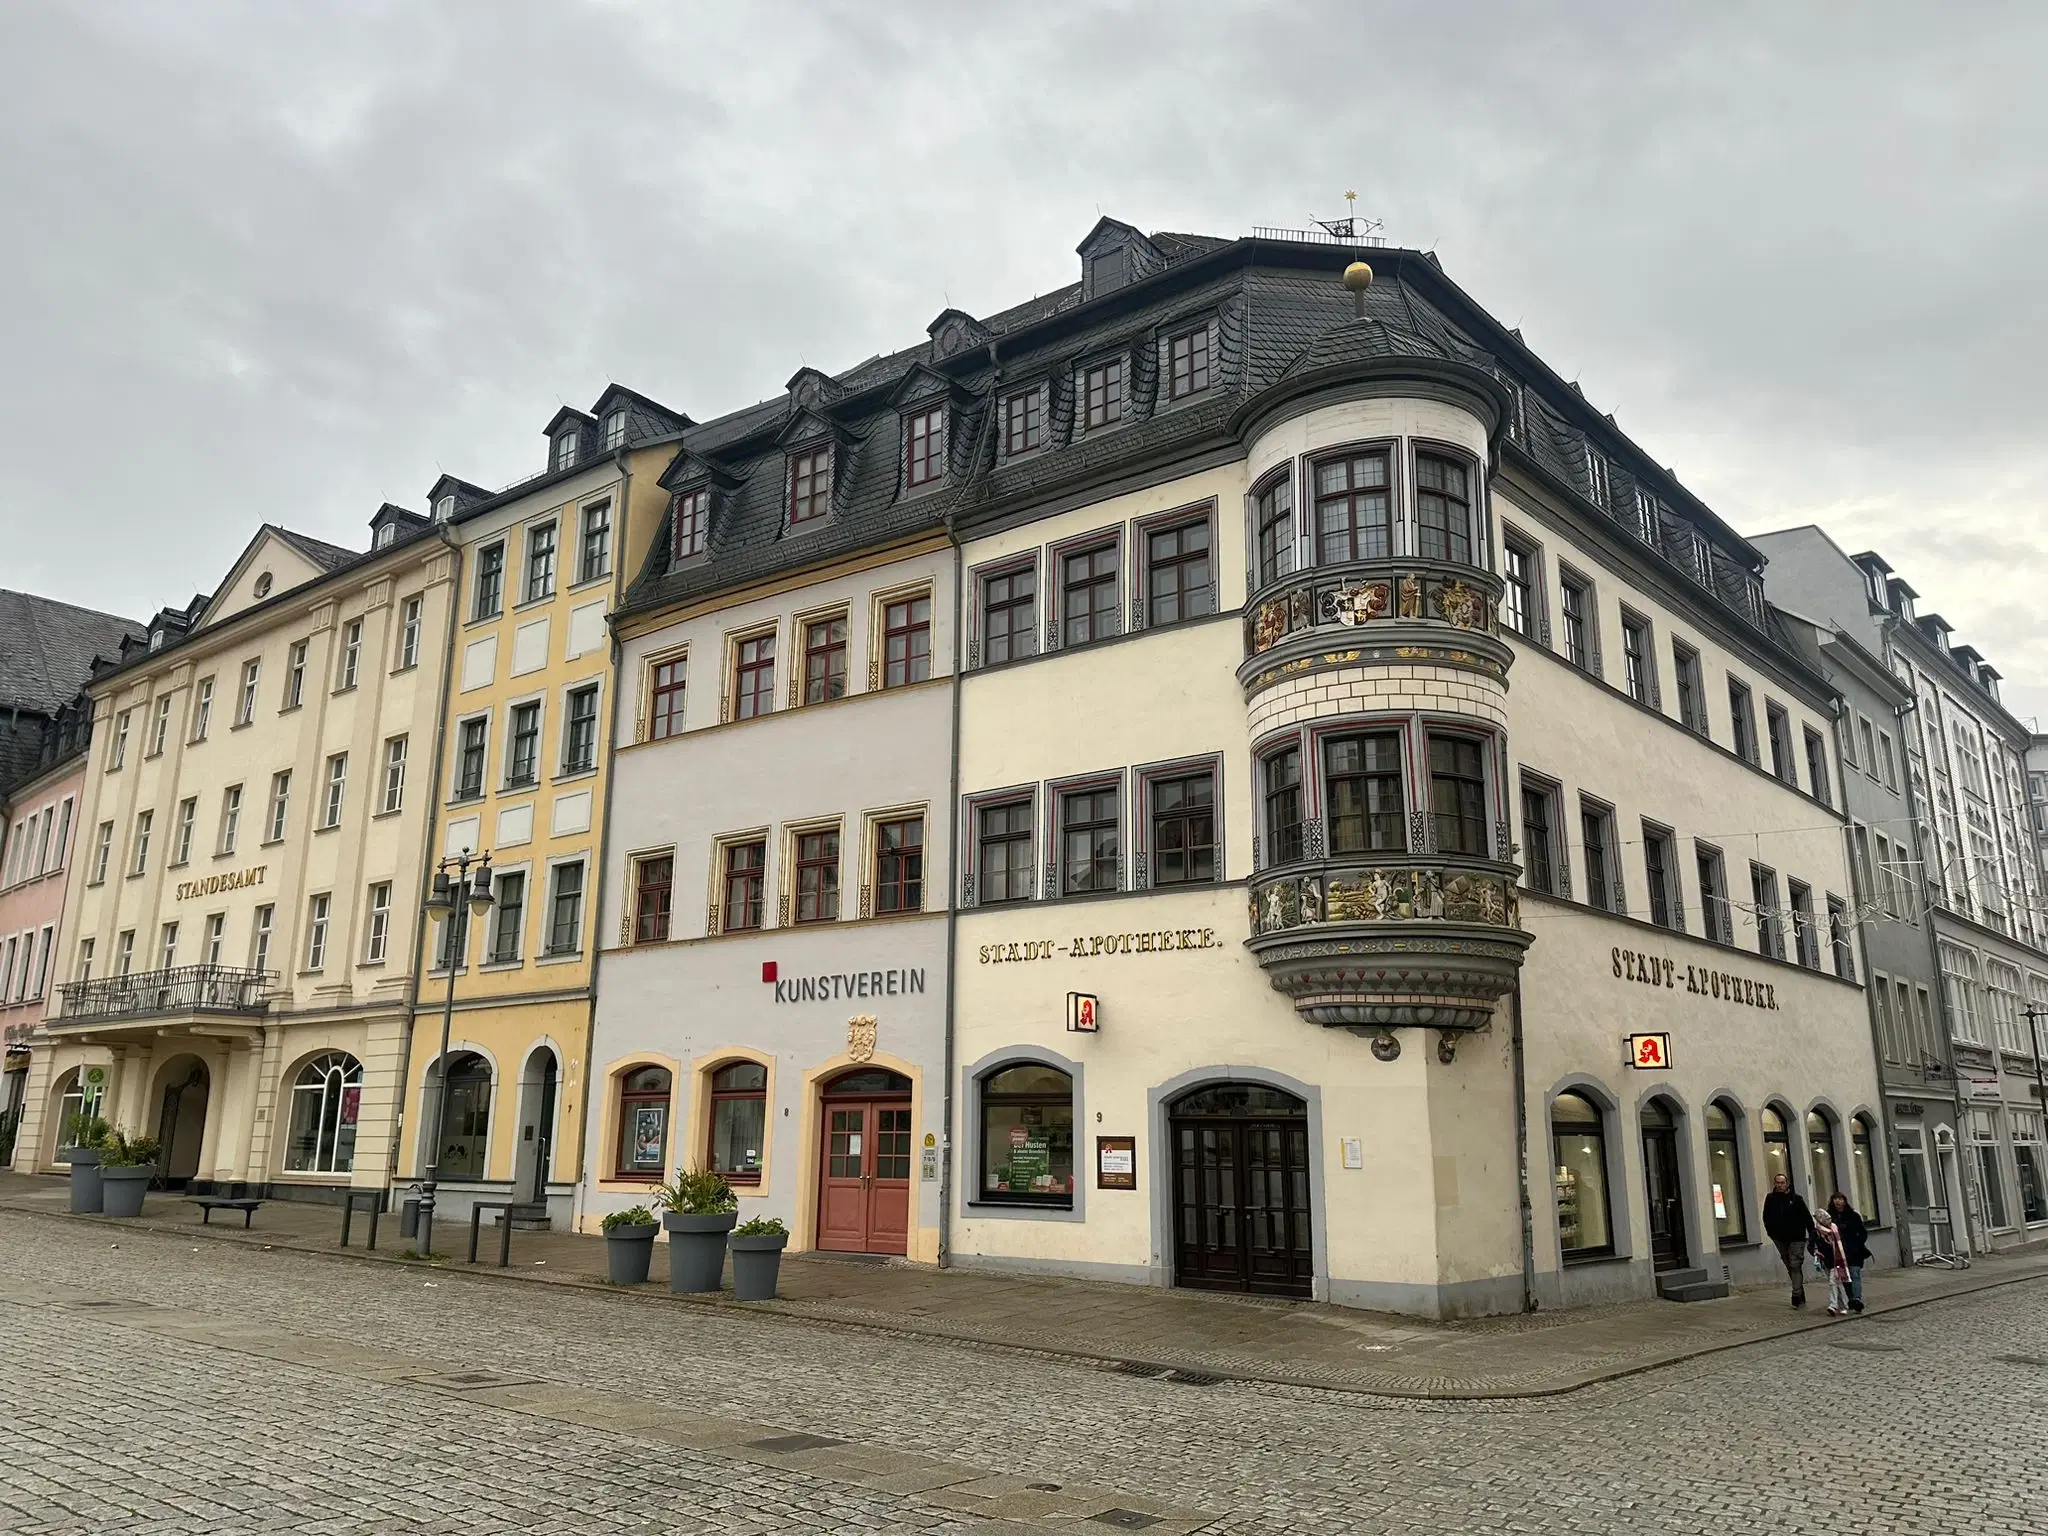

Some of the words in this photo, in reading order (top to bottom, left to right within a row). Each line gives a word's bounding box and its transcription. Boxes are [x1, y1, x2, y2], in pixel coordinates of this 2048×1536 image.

[176, 865, 268, 901] STANDESAMT
[978, 927, 1224, 964] STADT-APOTHEKE.
[775, 967, 925, 1004] KUNSTVEREIN
[1096, 1112, 1102, 1123] 9
